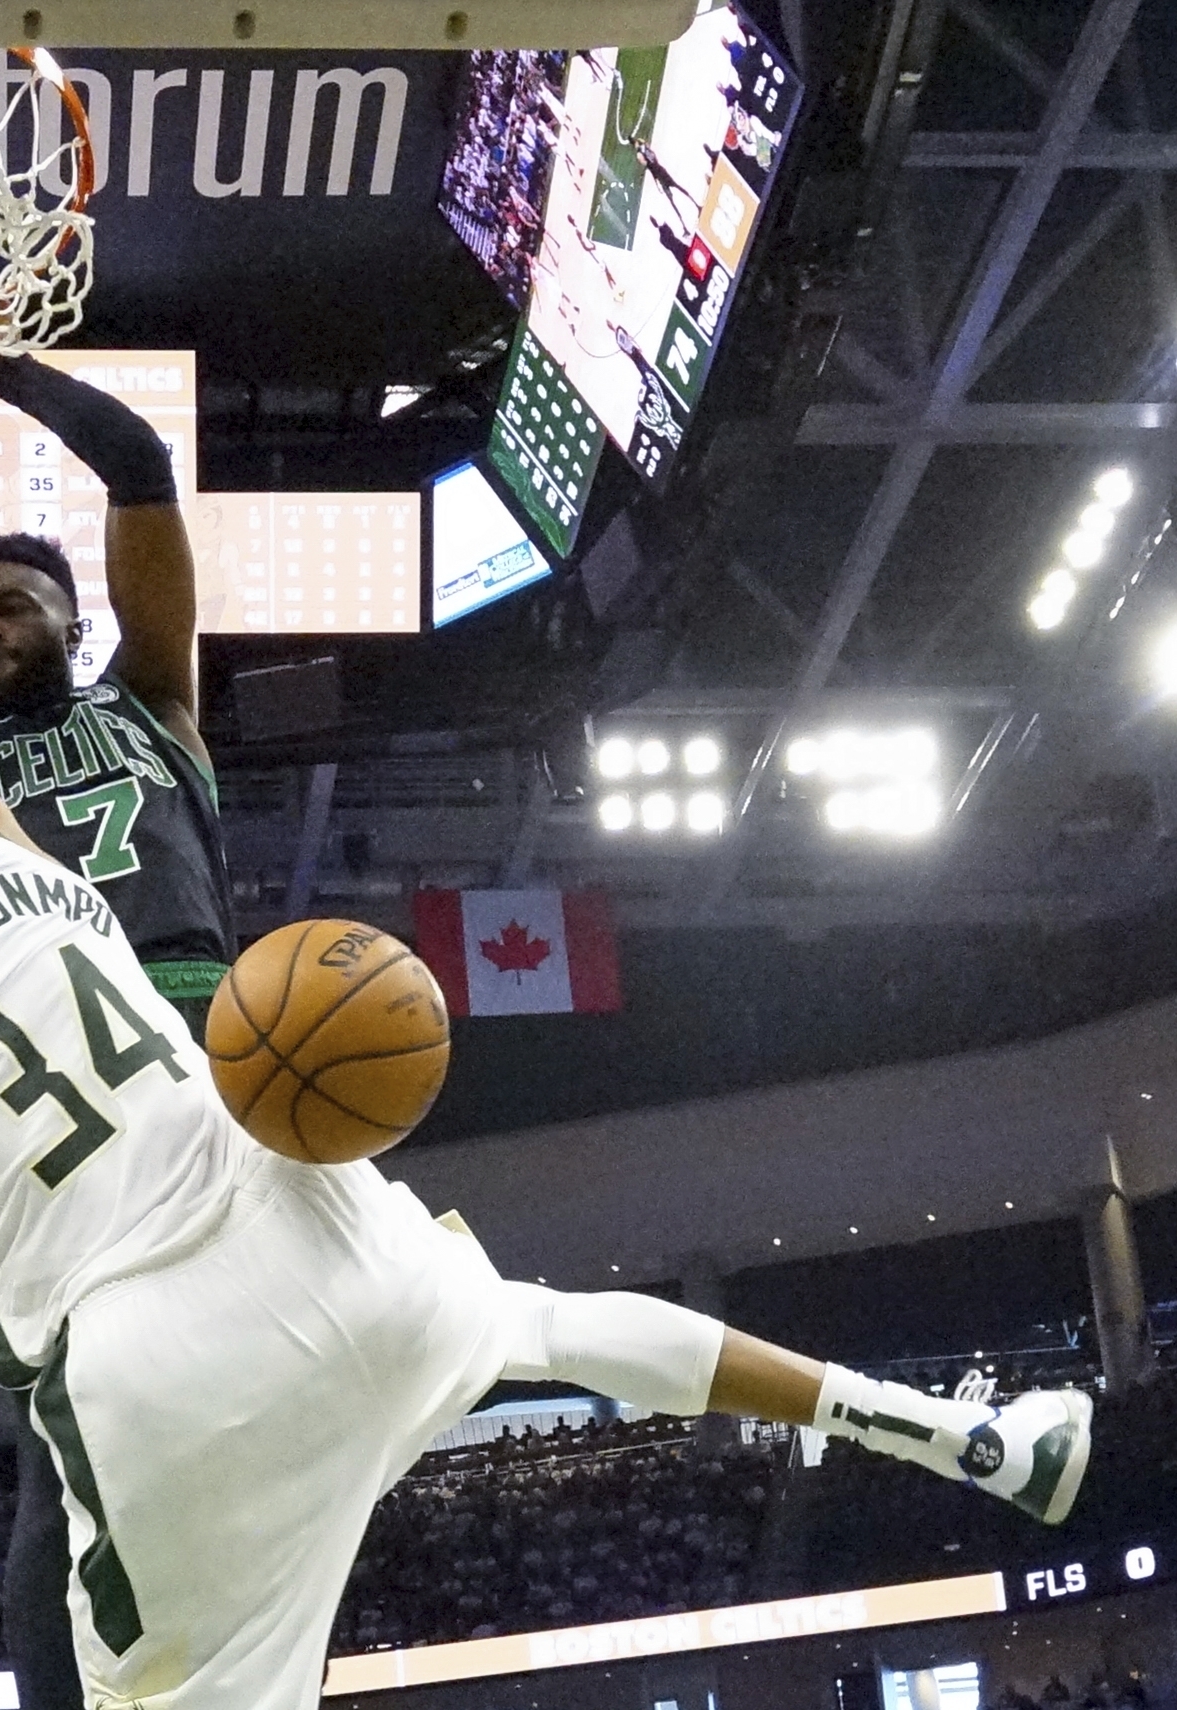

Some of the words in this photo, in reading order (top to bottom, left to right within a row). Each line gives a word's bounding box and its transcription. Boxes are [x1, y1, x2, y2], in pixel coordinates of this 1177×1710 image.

[666, 327, 698, 385] 74
[34, 442, 46, 457] 2
[29, 477, 54, 491] 35
[36, 513, 47, 528] 7
[55, 776, 145, 883] 7
[1026, 1563, 1087, 1601] FLS
[1125, 1546, 1156, 1580] 0
[529, 1614, 701, 1666] BOSTON
[710, 1594, 869, 1643] CELTICS
